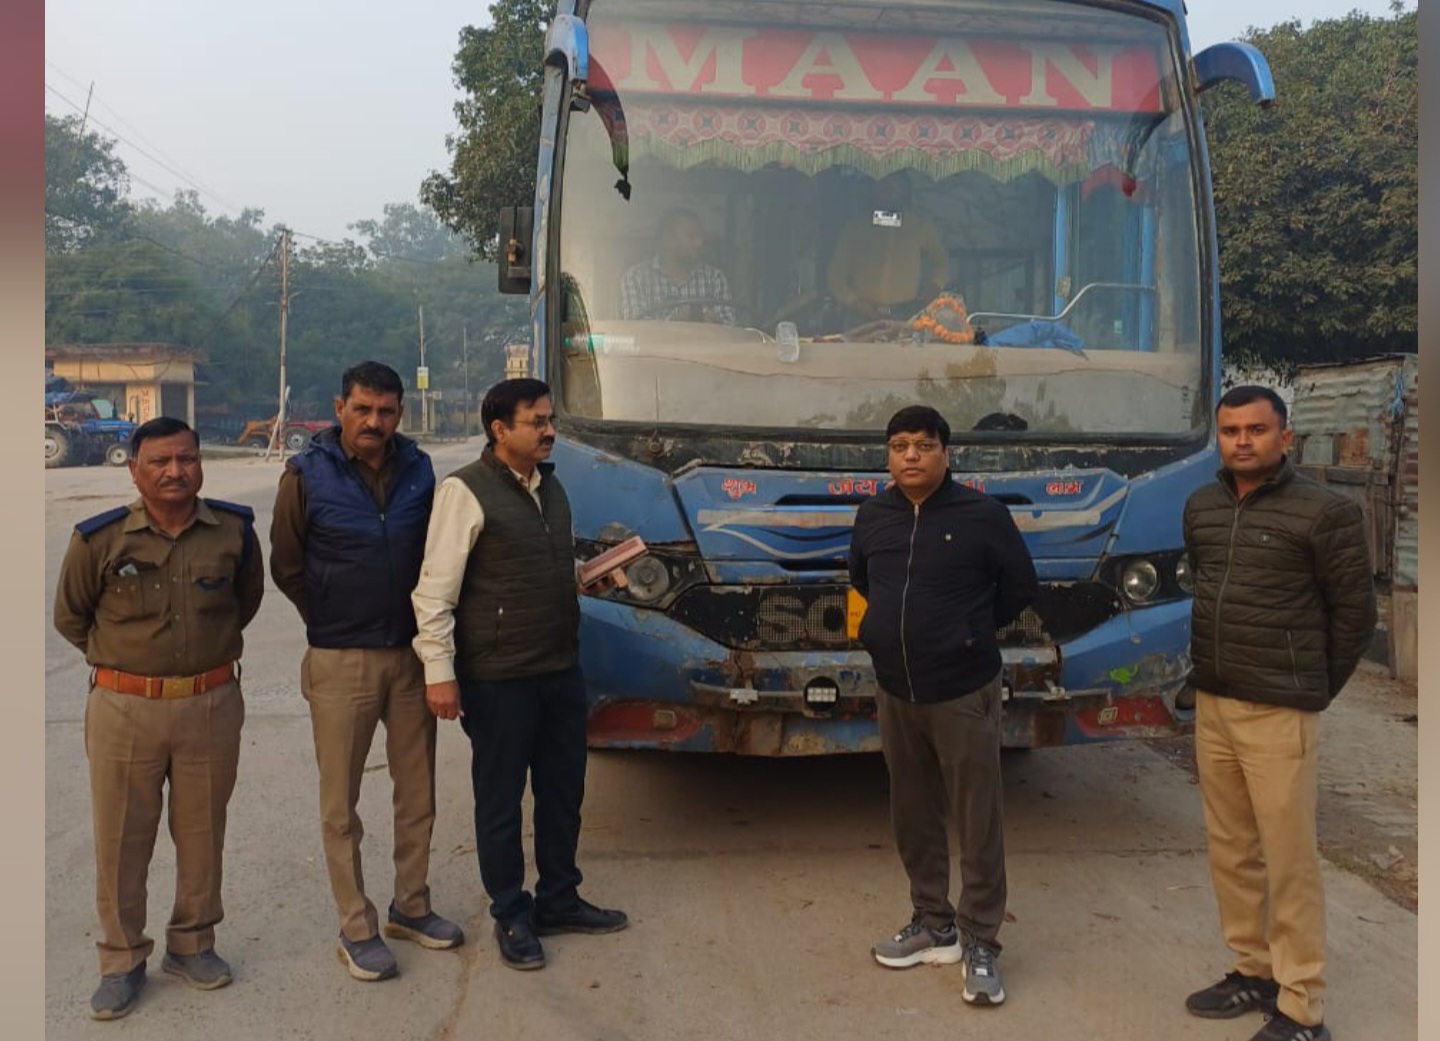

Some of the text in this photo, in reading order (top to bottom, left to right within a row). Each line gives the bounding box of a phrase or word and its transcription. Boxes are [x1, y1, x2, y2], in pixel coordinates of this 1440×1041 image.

[617, 24, 1128, 109] MAAN
[721, 477, 757, 500] शुभ
[828, 477, 878, 496] जय
[1045, 479, 1084, 496] लाभ
